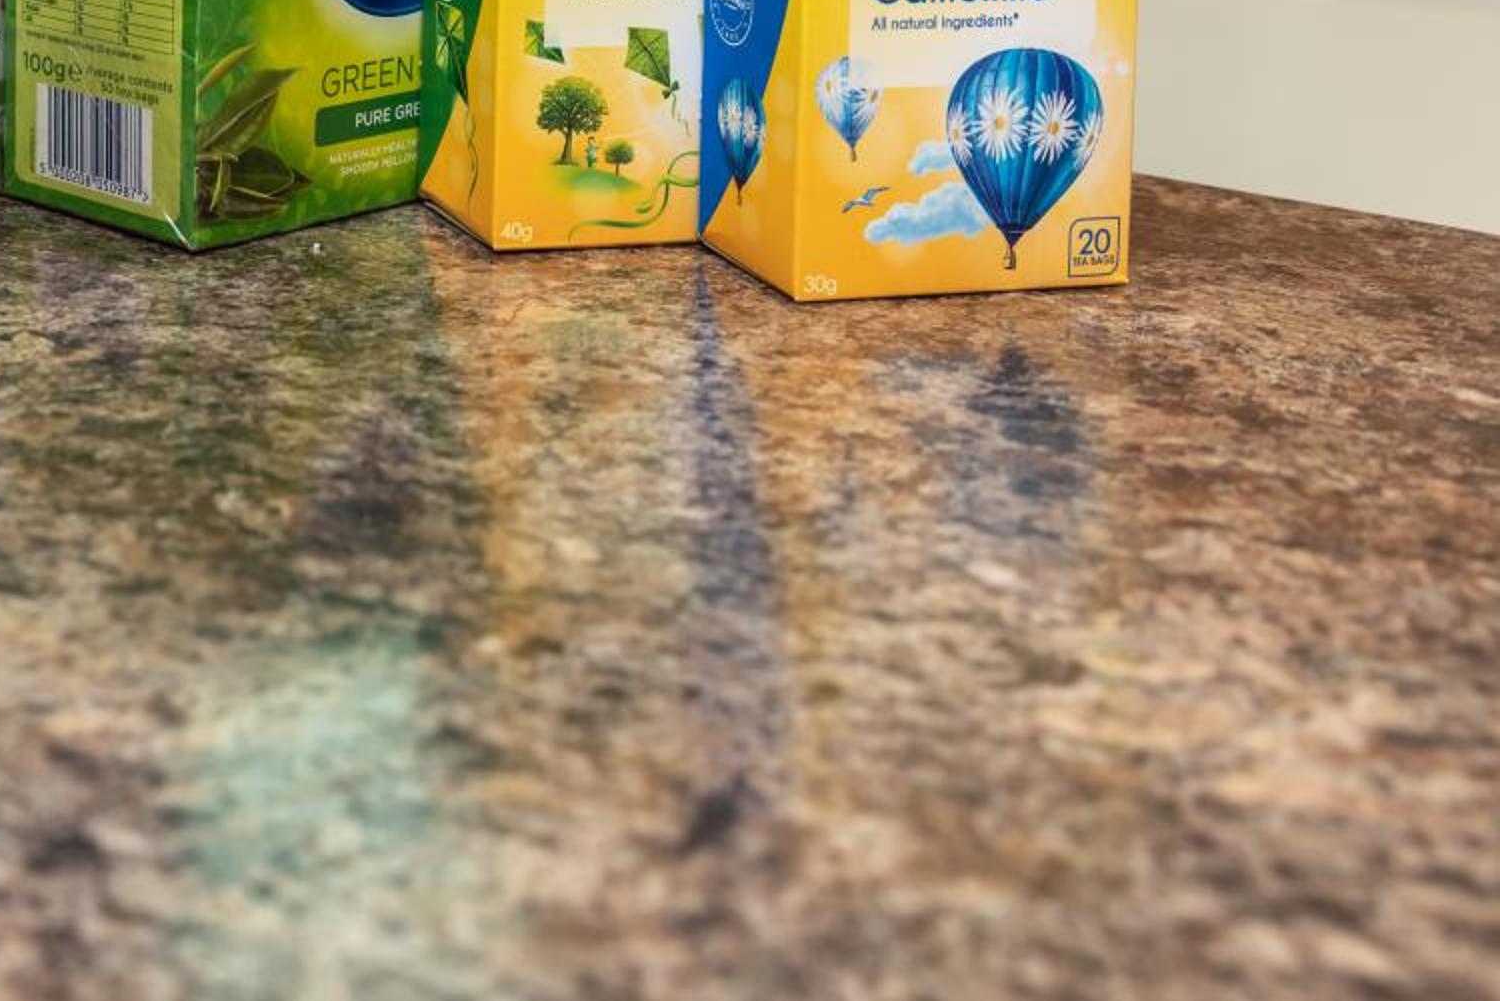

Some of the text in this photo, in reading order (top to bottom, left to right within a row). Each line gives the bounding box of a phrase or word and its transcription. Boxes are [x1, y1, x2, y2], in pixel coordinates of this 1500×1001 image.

[872, 17, 887, 30] All
[891, 15, 937, 30] natural
[322, 55, 414, 98] GREEN
[355, 107, 391, 127] PURE
[501, 223, 532, 241] 40g
[1079, 229, 1111, 255] 20
[1073, 255, 1115, 266] TEA BAGS
[804, 276, 836, 295] 30g
